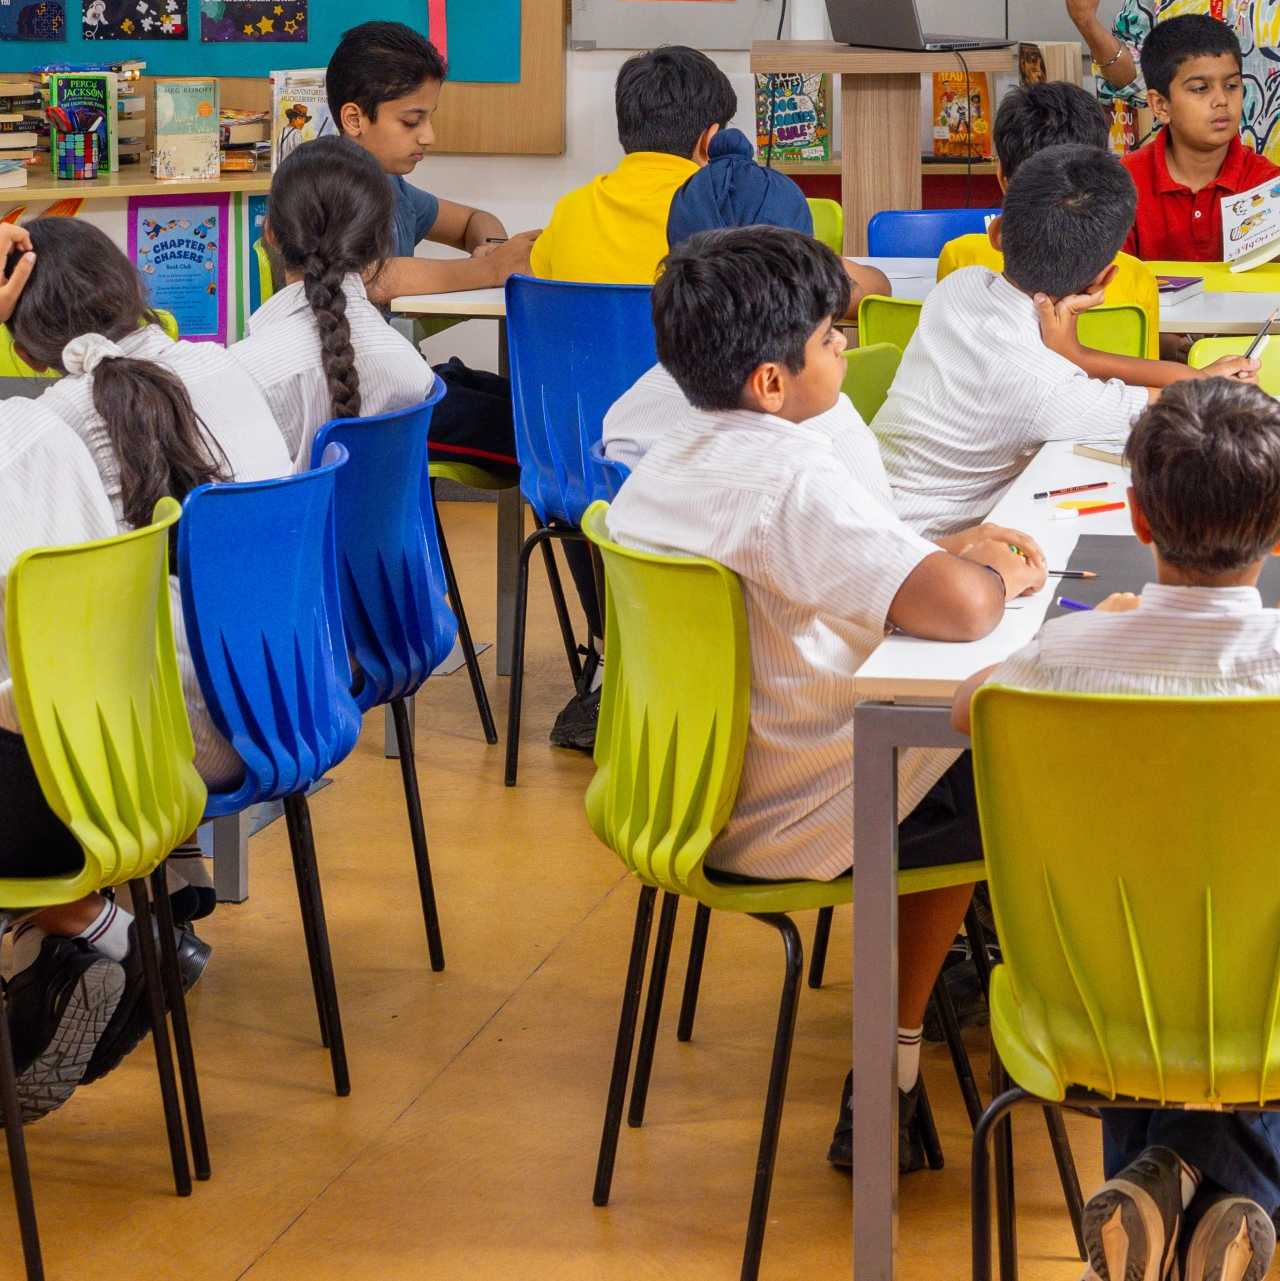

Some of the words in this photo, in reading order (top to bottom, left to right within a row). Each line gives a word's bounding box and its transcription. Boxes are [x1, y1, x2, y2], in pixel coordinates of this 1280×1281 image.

[70, 80, 97, 89] PERCY
[63, 88, 103, 100] JACKSON
[1111, 112, 1132, 125] YOU
[1115, 133, 1135, 145] AND
[153, 239, 206, 254] CHAPTER
[154, 251, 203, 264] CHASERS
